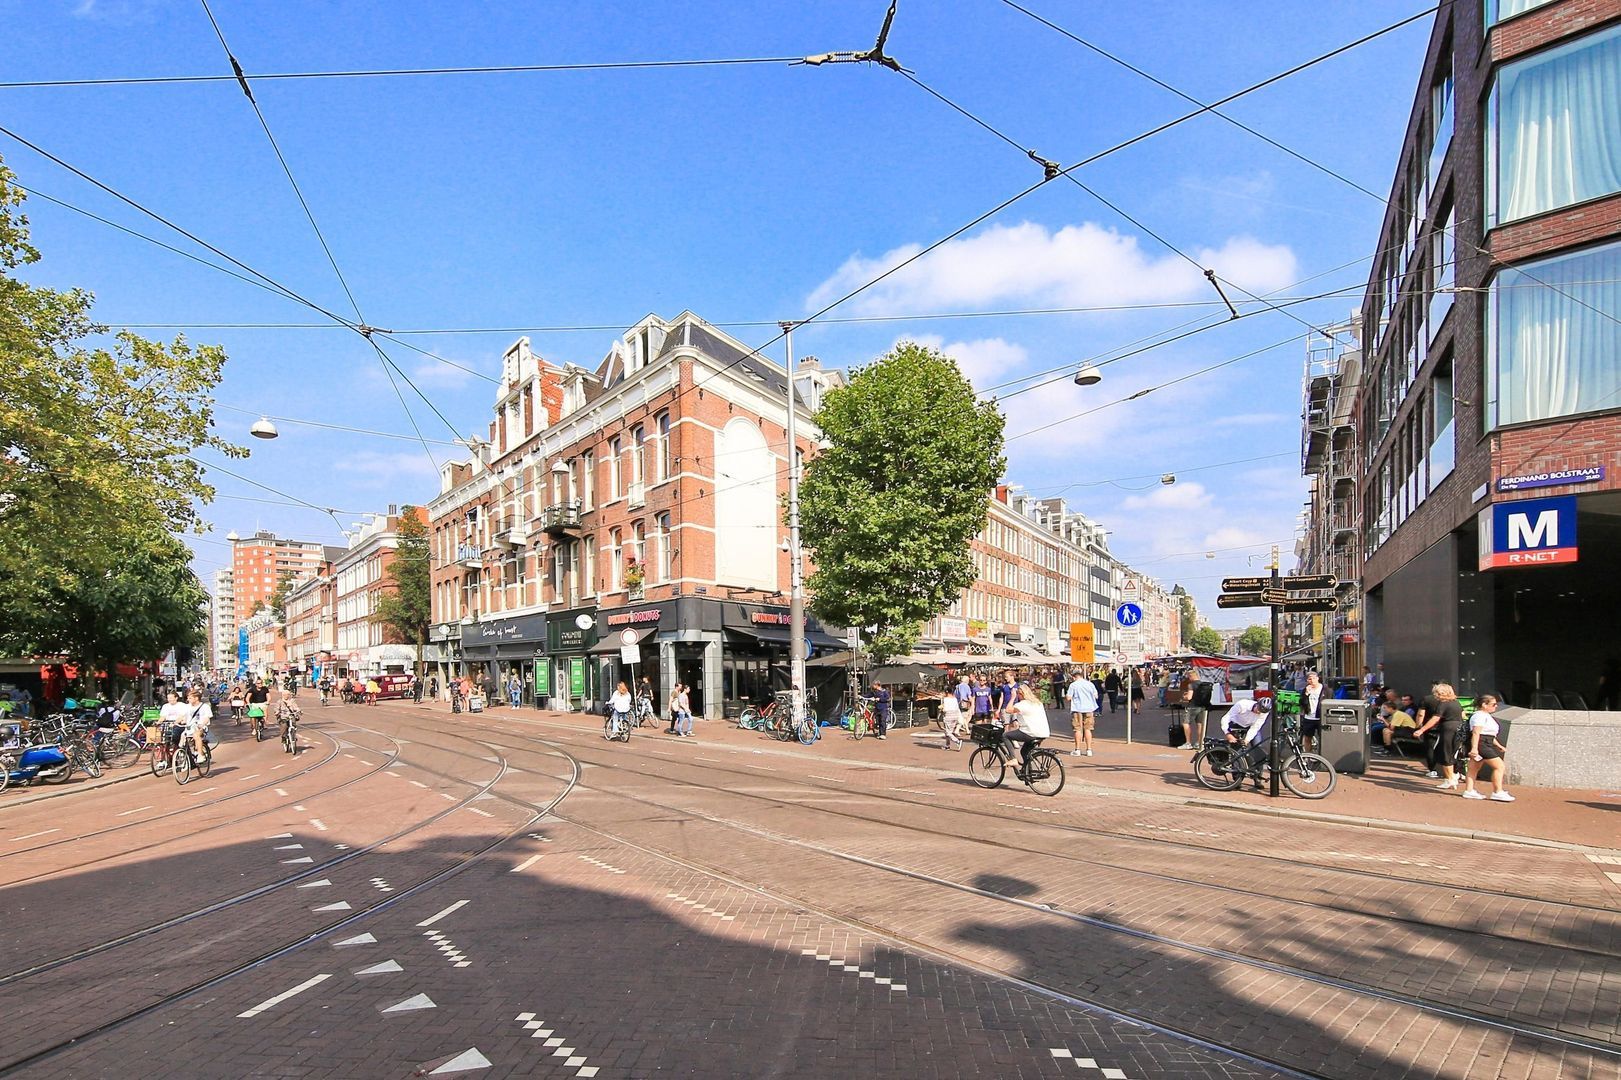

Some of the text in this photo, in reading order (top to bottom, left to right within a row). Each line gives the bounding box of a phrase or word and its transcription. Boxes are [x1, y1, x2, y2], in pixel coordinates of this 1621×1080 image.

[1501, 467, 1600, 485] FERDINAND BOLSTRAAT
[1508, 509, 1558, 550] M
